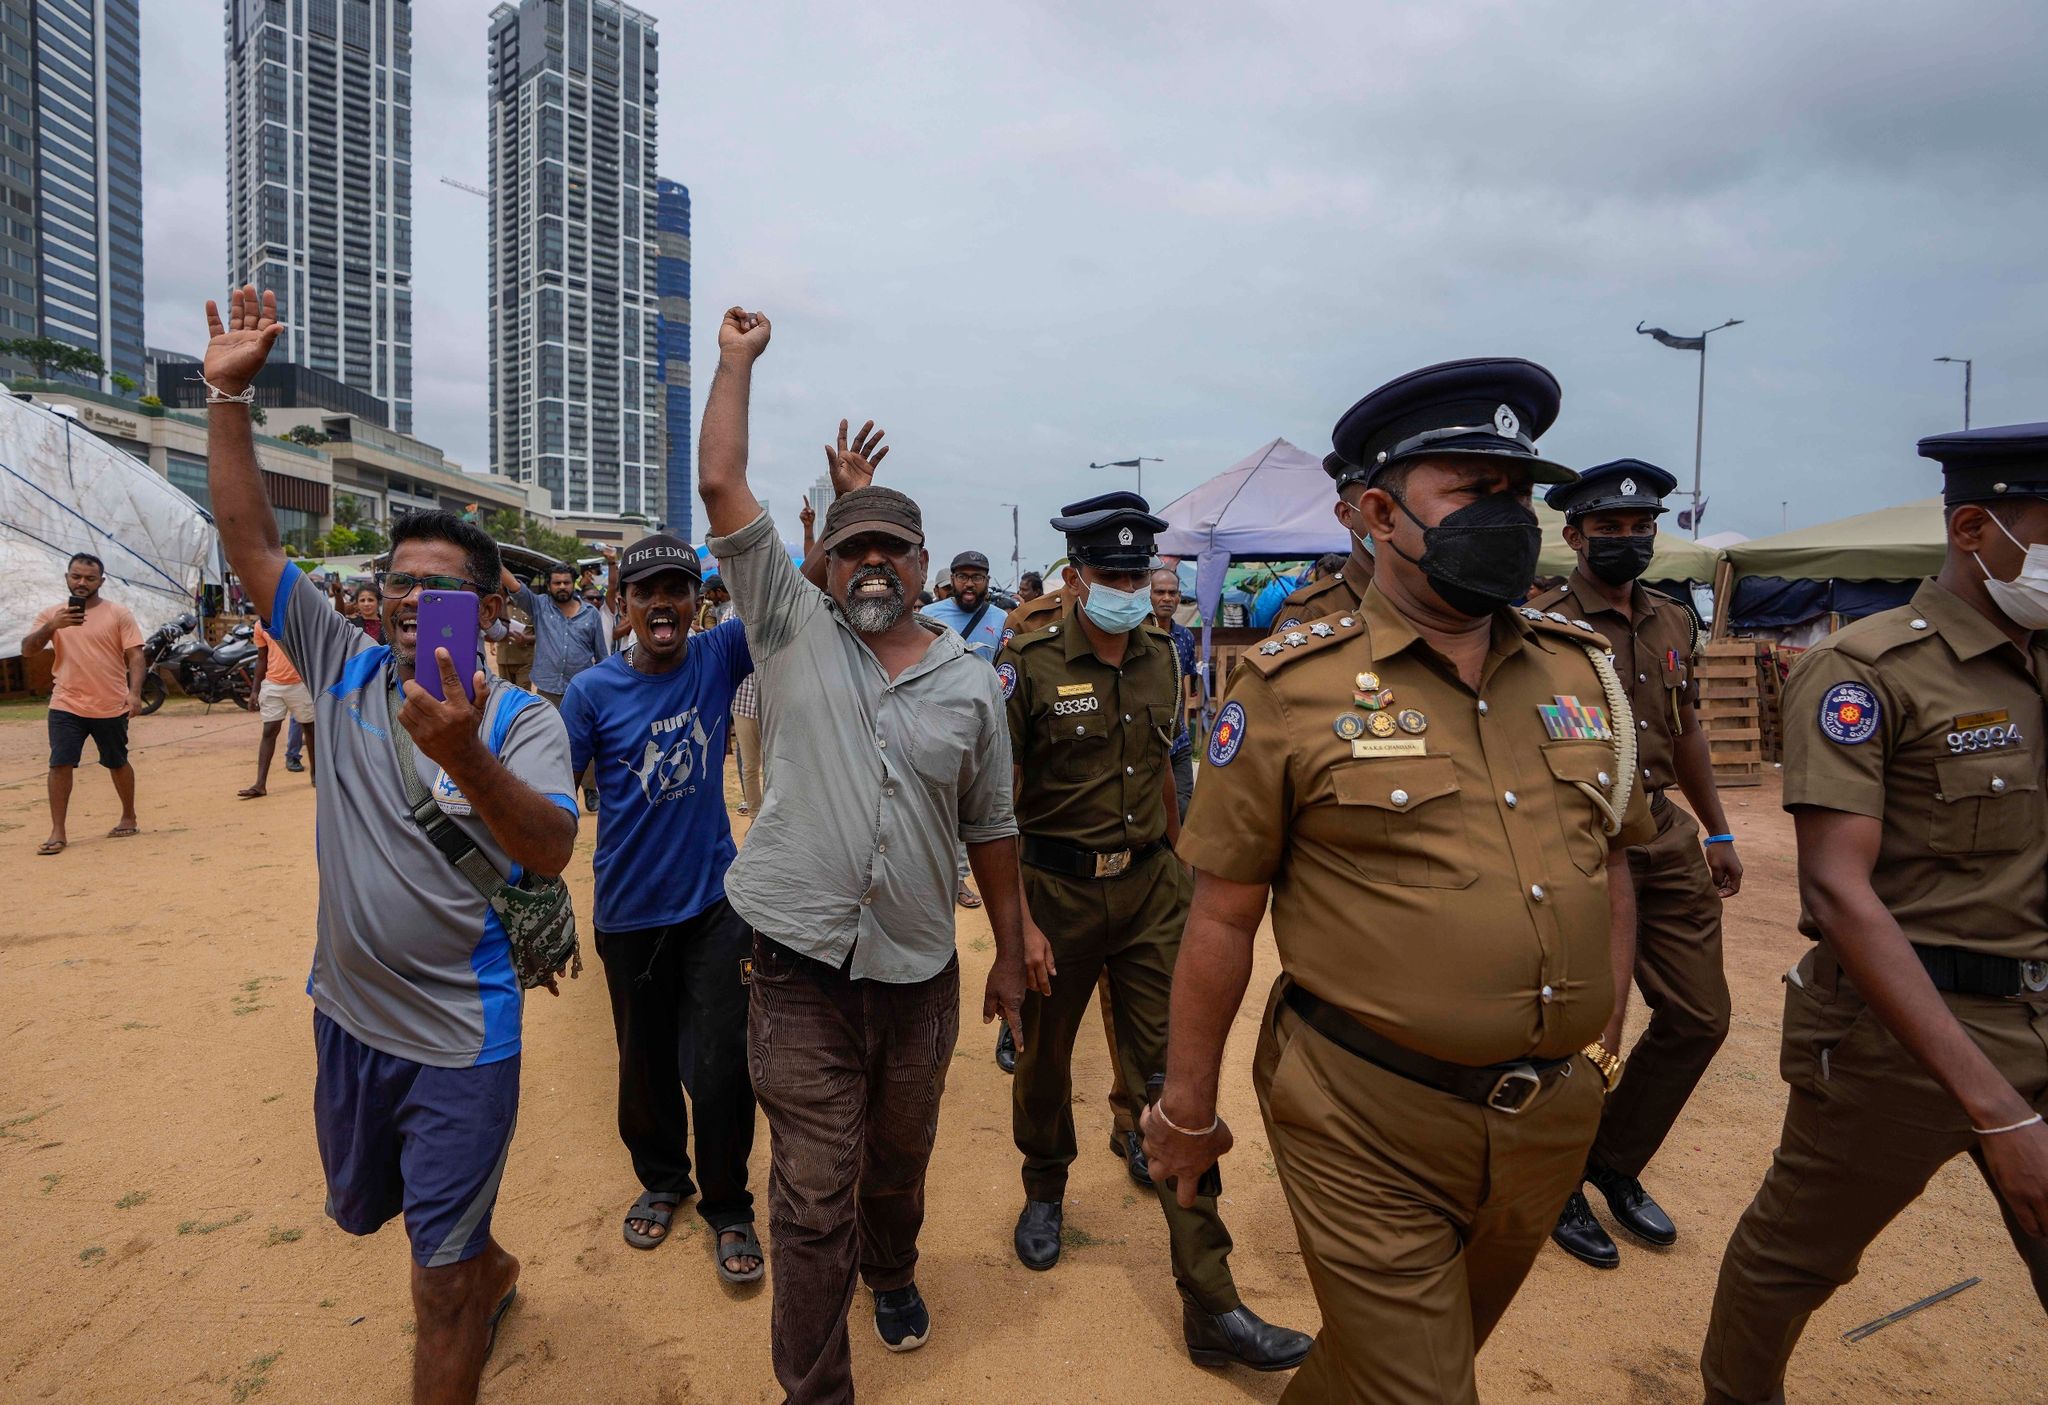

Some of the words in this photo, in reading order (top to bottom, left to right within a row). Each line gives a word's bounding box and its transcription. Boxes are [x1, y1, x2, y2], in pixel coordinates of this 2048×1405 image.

[628, 546, 696, 565] FREEDOM
[1053, 696, 1099, 715] 93350
[1826, 711, 1843, 735] POLICE
[1946, 723, 2024, 753] 93994
